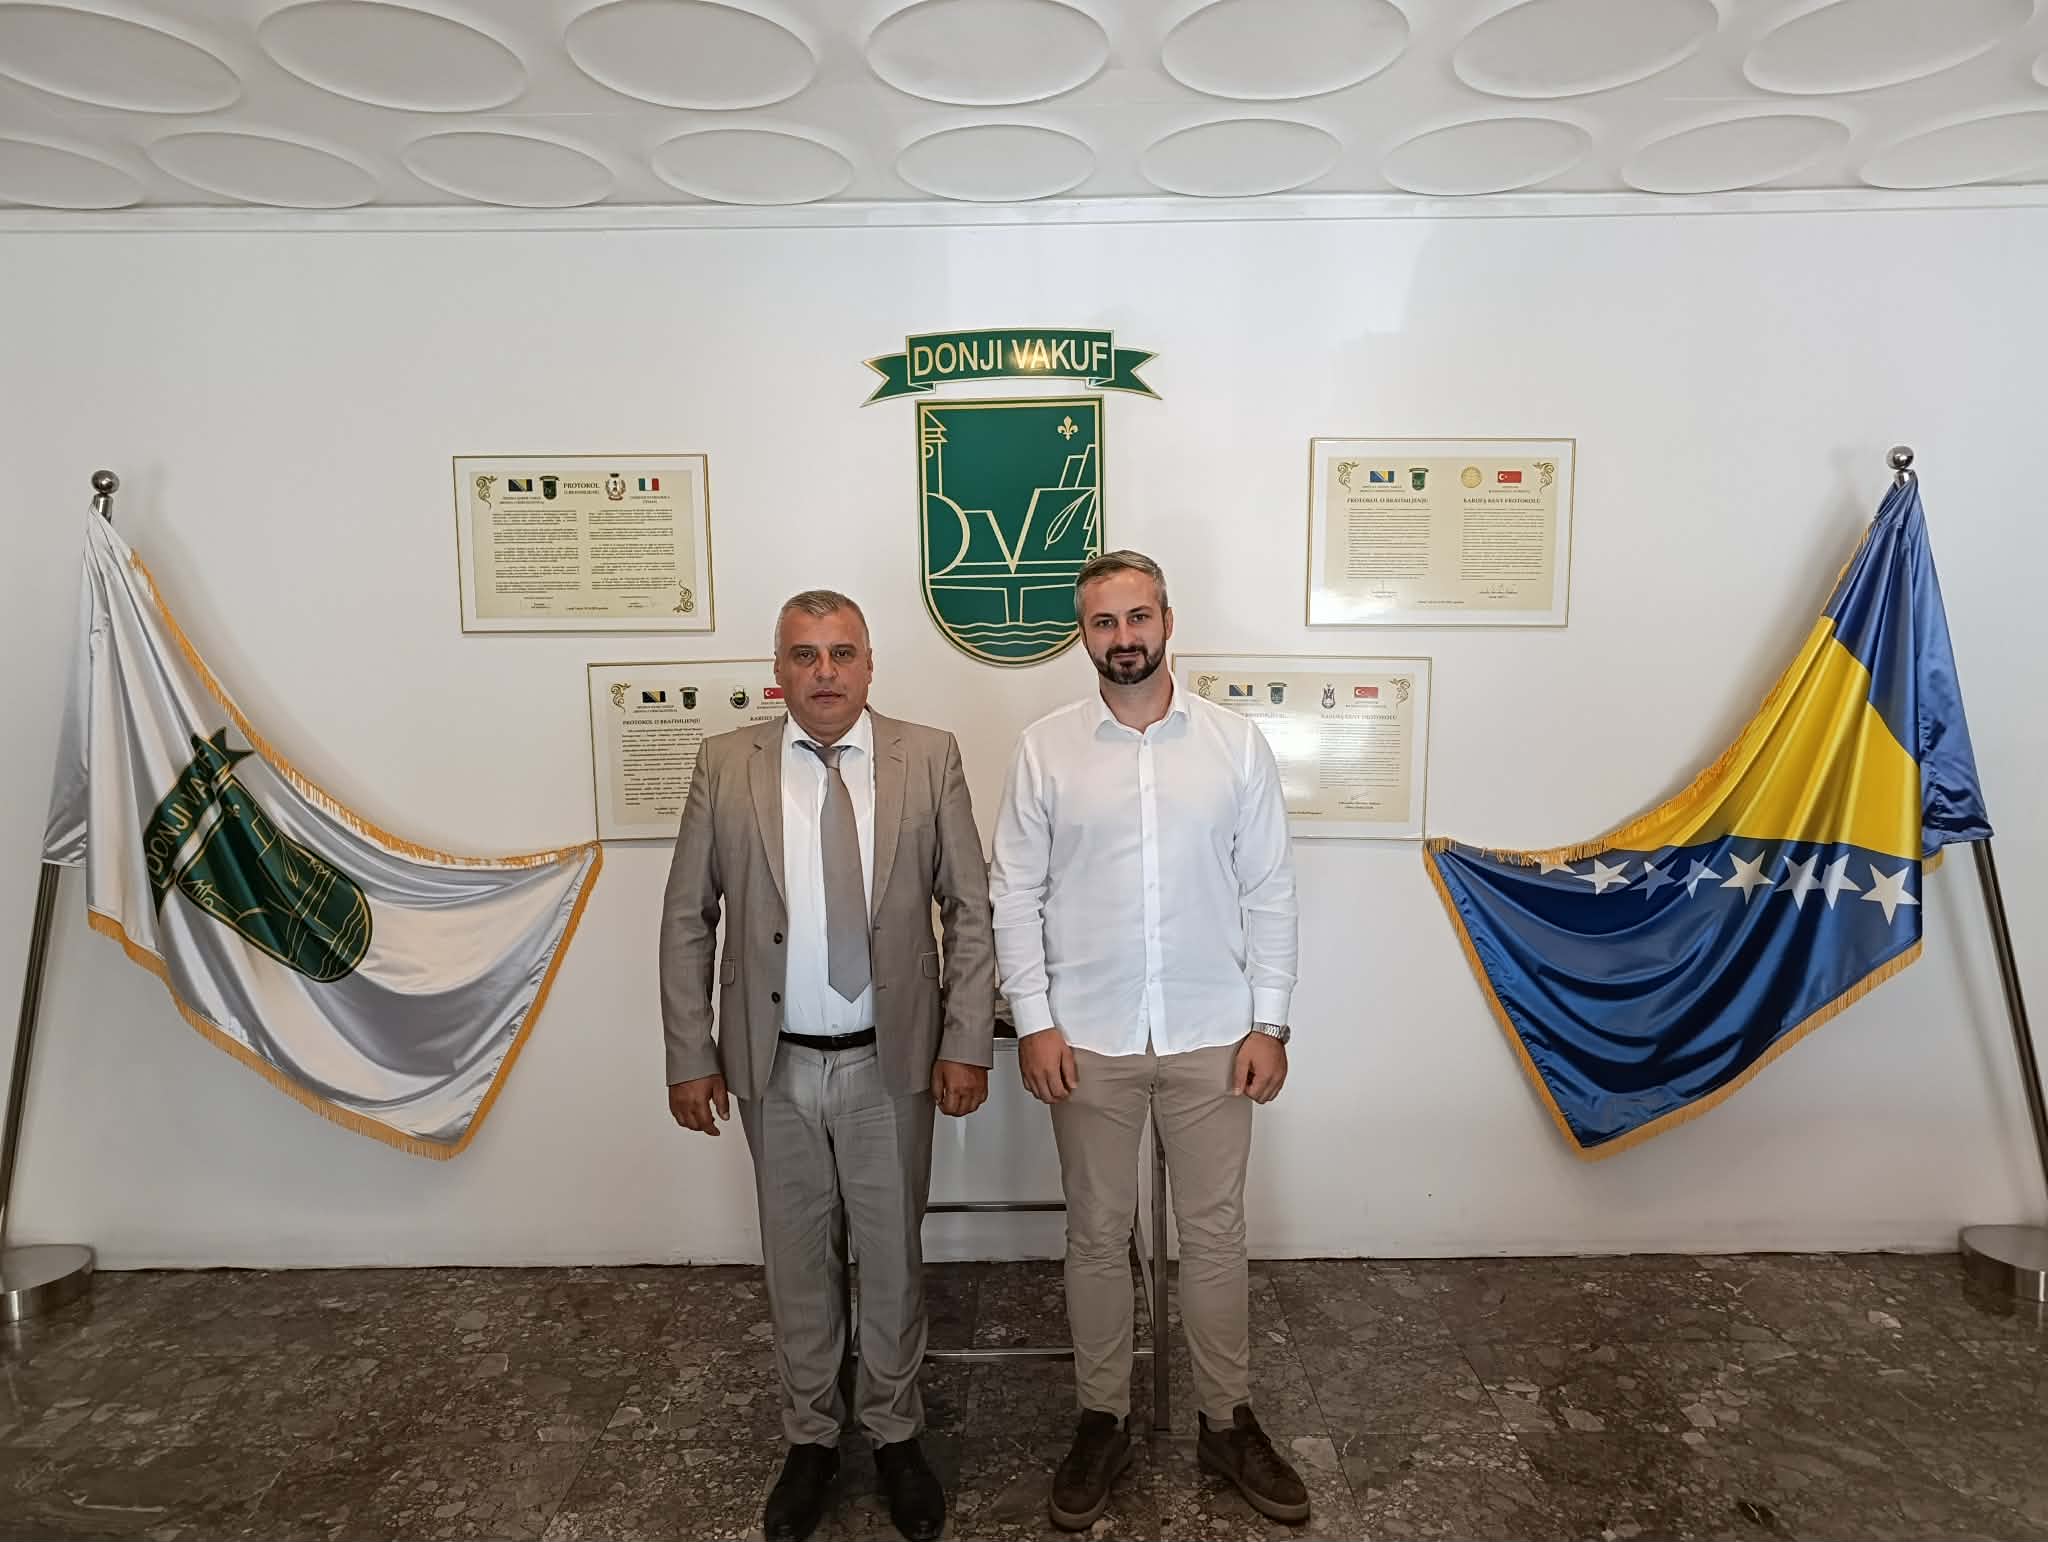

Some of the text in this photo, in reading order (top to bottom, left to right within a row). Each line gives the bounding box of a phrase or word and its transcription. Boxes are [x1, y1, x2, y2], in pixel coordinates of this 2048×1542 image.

[914, 339, 1109, 377] DONJI VAKUF
[147, 803, 193, 876] DONJI
